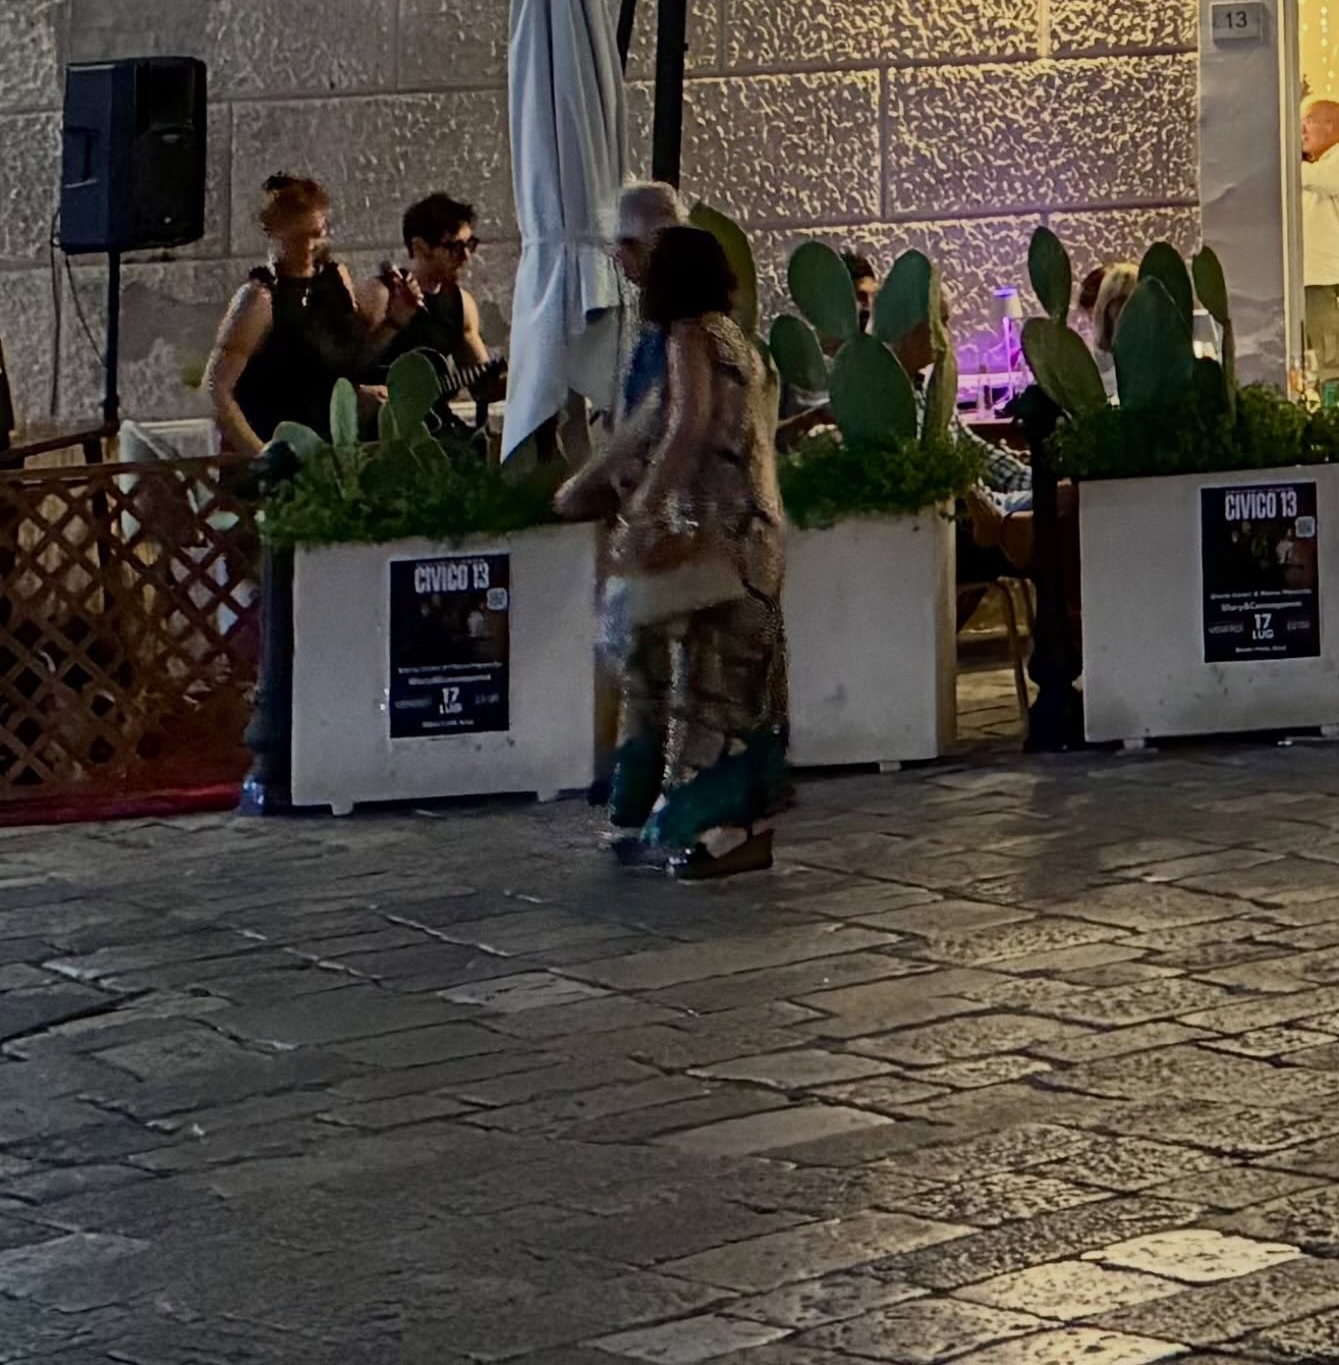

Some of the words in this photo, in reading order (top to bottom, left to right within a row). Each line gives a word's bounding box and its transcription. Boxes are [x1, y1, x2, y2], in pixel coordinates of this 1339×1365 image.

[1225, 10, 1248, 30] 13
[1225, 492, 1277, 521] CIVICO
[1280, 491, 1297, 518] 13
[414, 563, 469, 594] CIVICO
[472, 561, 490, 589] 13
[1254, 613, 1272, 630] 17
[1251, 629, 1274, 640] LUG
[441, 686, 460, 703] 17
